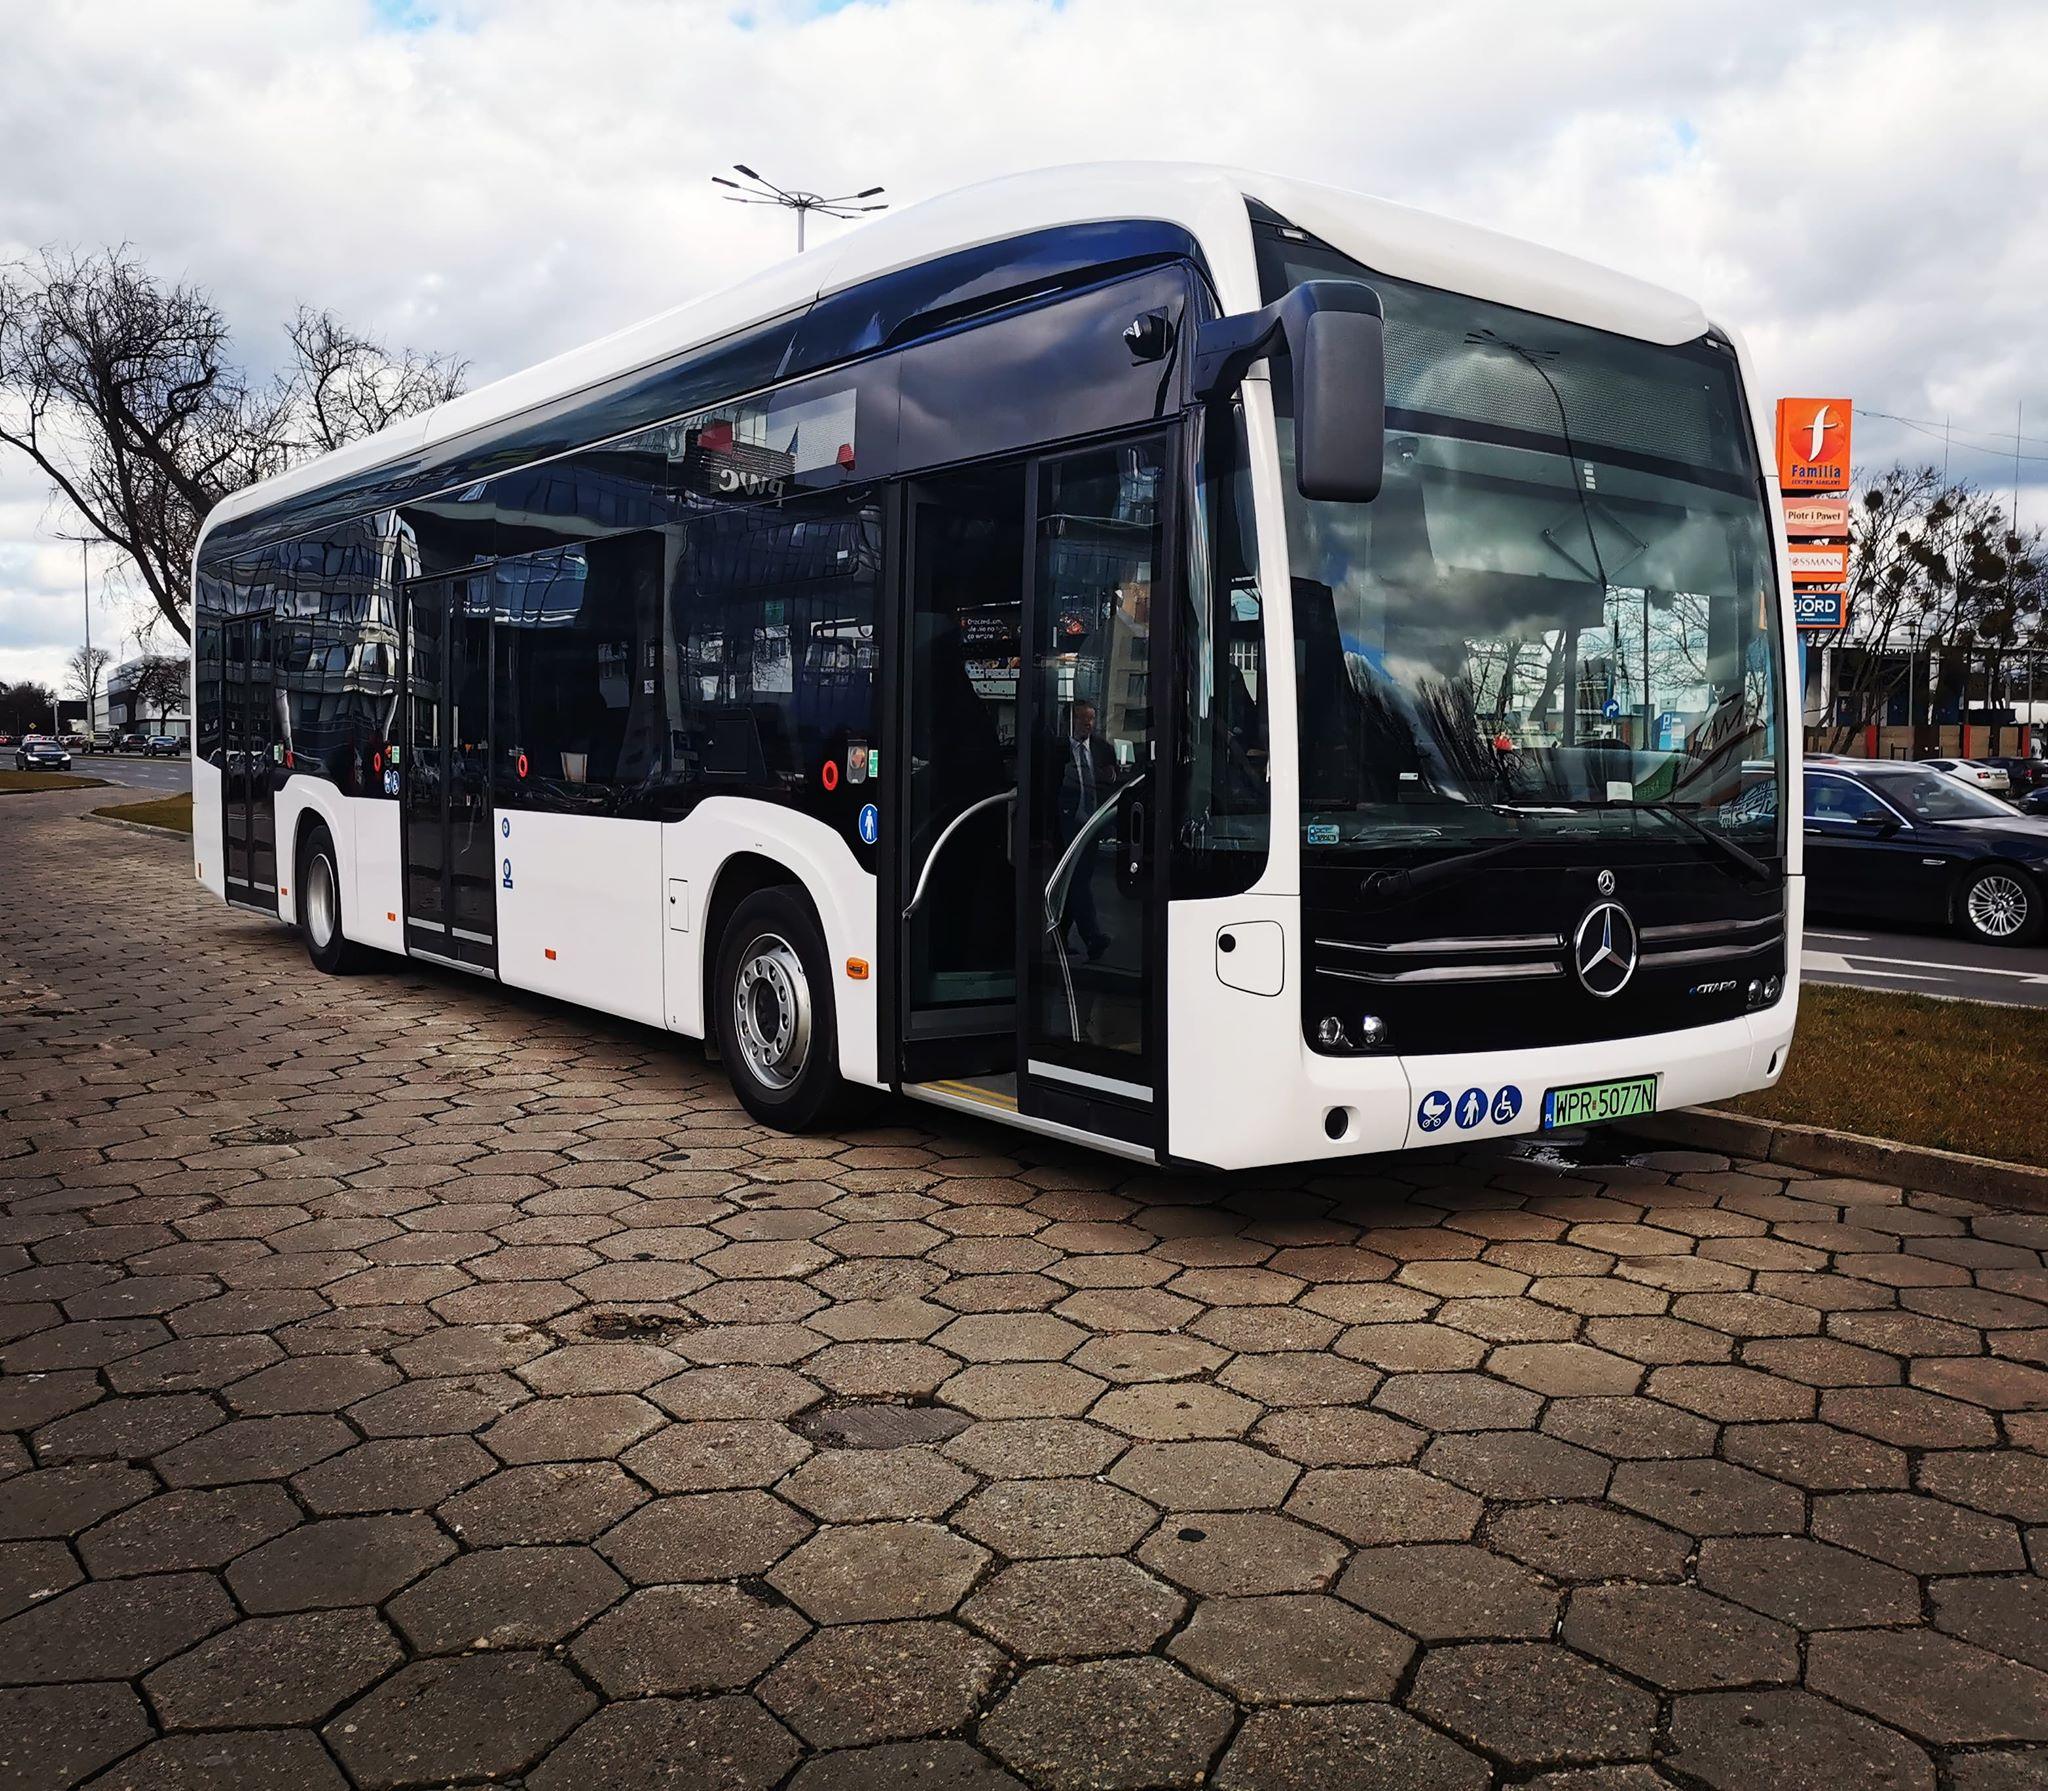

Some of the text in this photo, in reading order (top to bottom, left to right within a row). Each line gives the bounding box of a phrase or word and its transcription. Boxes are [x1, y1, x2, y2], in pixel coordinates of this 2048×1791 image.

[1791, 464, 1841, 478] Familia
[1788, 511, 1810, 520] Piotr
[1790, 557, 1842, 567] OSSMANN
[1556, 1083, 1653, 1123] WPR 5077N
